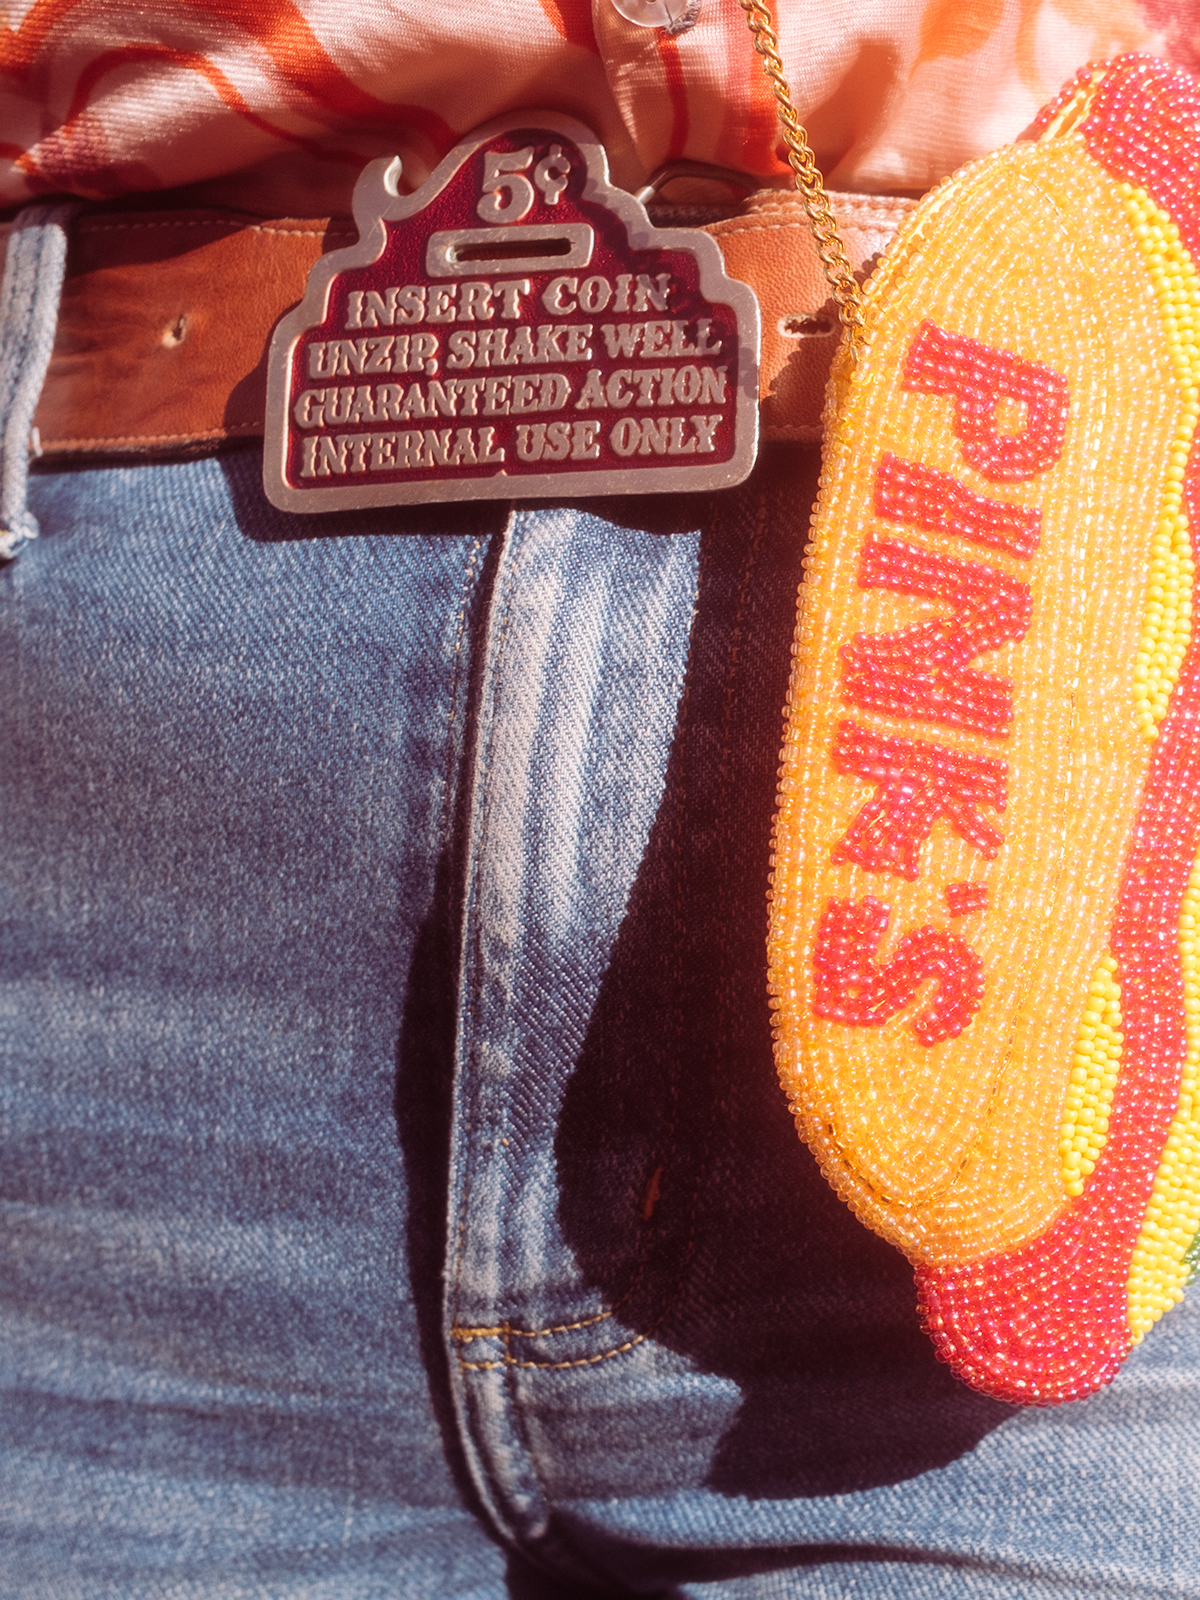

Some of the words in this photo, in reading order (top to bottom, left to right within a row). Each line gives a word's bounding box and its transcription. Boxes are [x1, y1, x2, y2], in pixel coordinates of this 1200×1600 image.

[344, 279, 531, 330] INSERT
[542, 273, 671, 315] COIN
[446, 324, 593, 369] SHAKE
[600, 318, 722, 358] WELL
[293, 374, 571, 429] GUARANTEED
[575, 365, 728, 410] ACTION
[300, 426, 505, 477] INTERNAL
[516, 420, 600, 462] USE
[609, 415, 723, 457] ONLY
[812, 318, 1071, 1048] PINK'S
